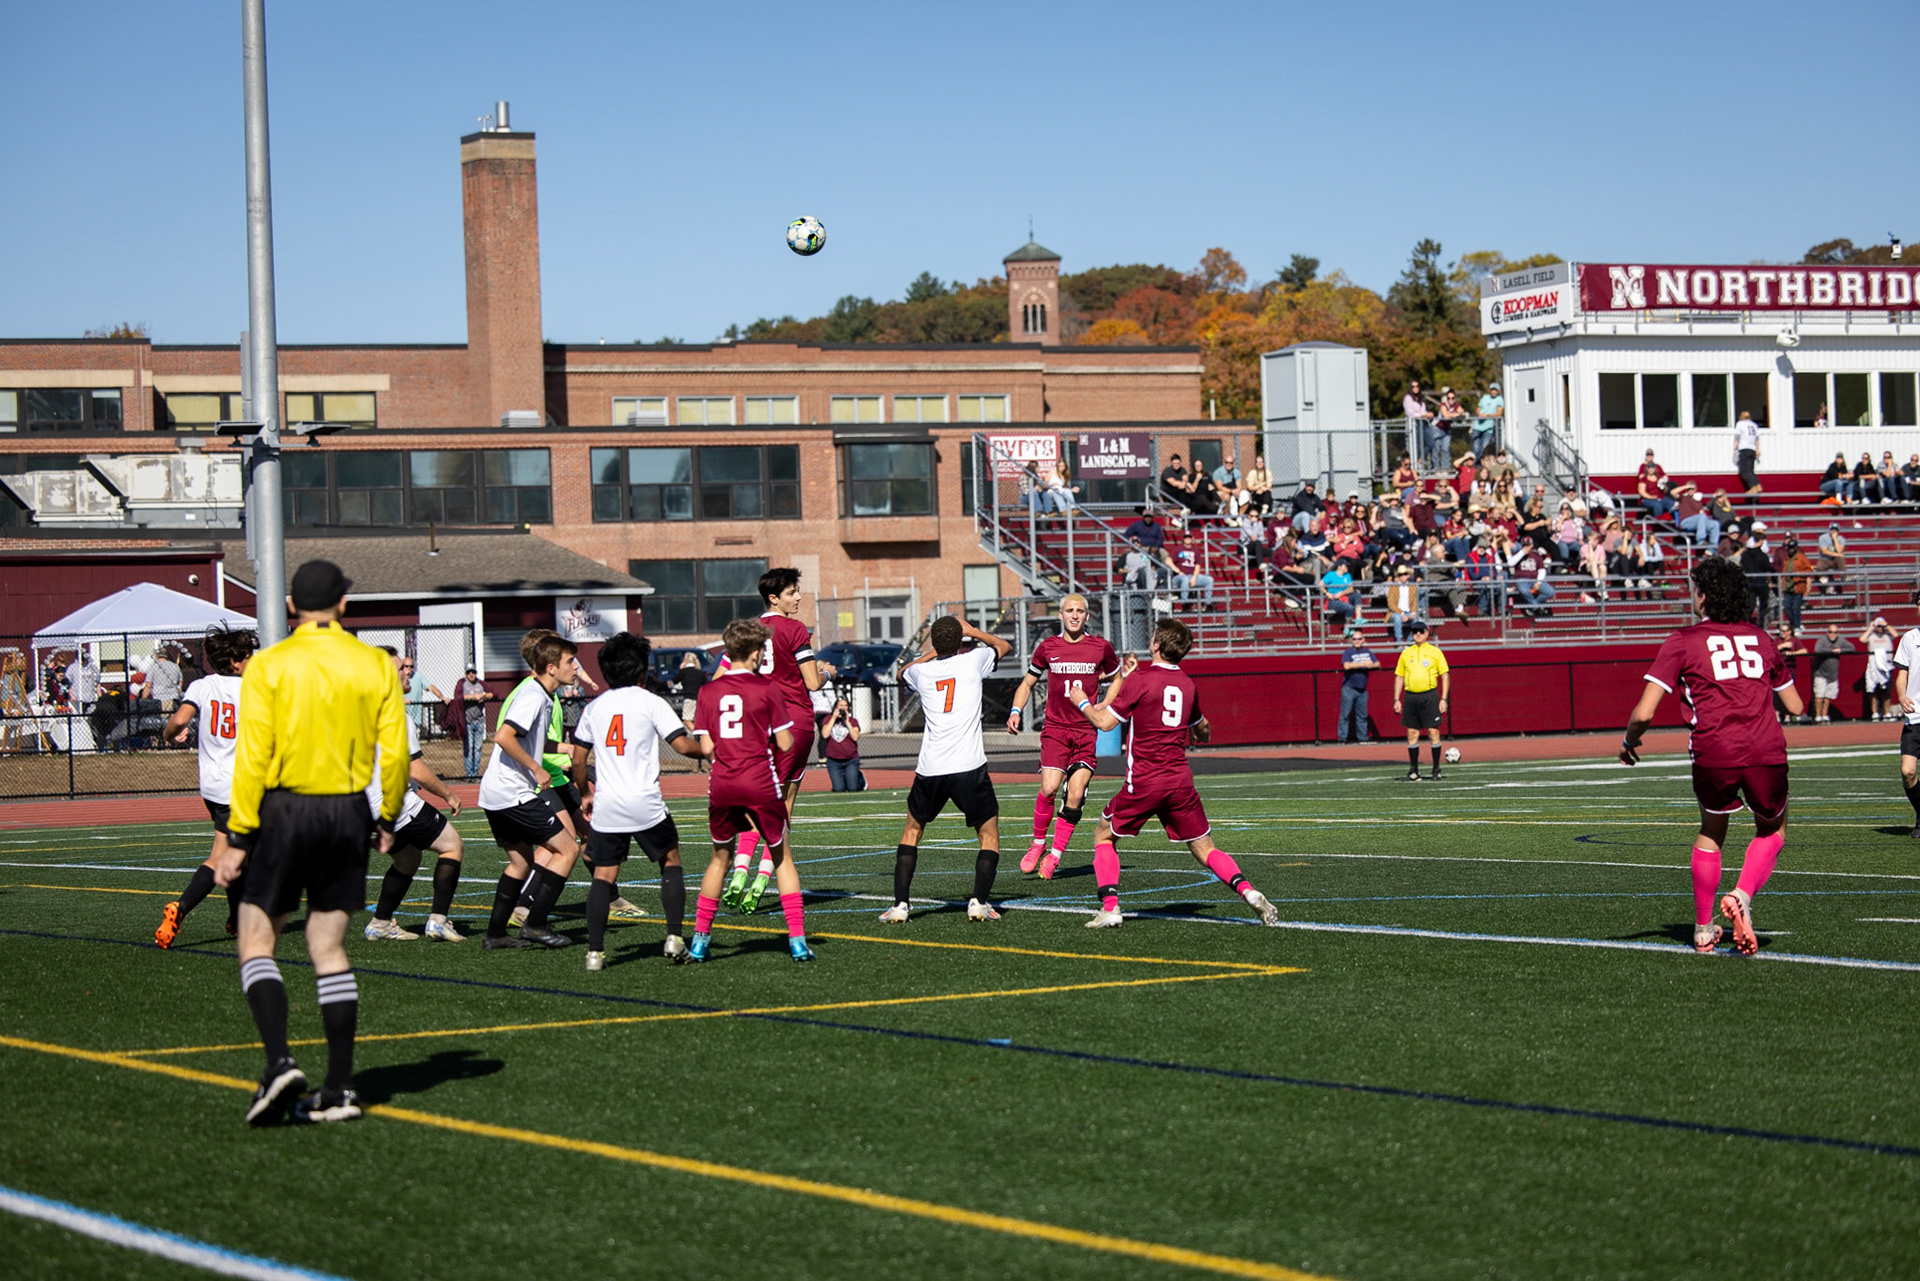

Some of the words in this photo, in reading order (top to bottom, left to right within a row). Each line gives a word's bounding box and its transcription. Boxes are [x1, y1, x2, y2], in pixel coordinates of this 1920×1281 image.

[1503, 275, 1531, 289] LASELL
[1533, 270, 1555, 284] FIELD
[1503, 291, 1559, 315] KOOPMAN
[1080, 454, 1136, 469] LANDSCAPE
[1099, 437, 1109, 454] L
[1109, 438, 1119, 454] &
[1118, 437, 1131, 454] M
[1706, 635, 1764, 681] 25
[935, 677, 956, 713] 7
[1161, 685, 1183, 727] 9
[210, 700, 236, 739] 13
[605, 714, 627, 756] 4
[719, 695, 743, 738] 2
